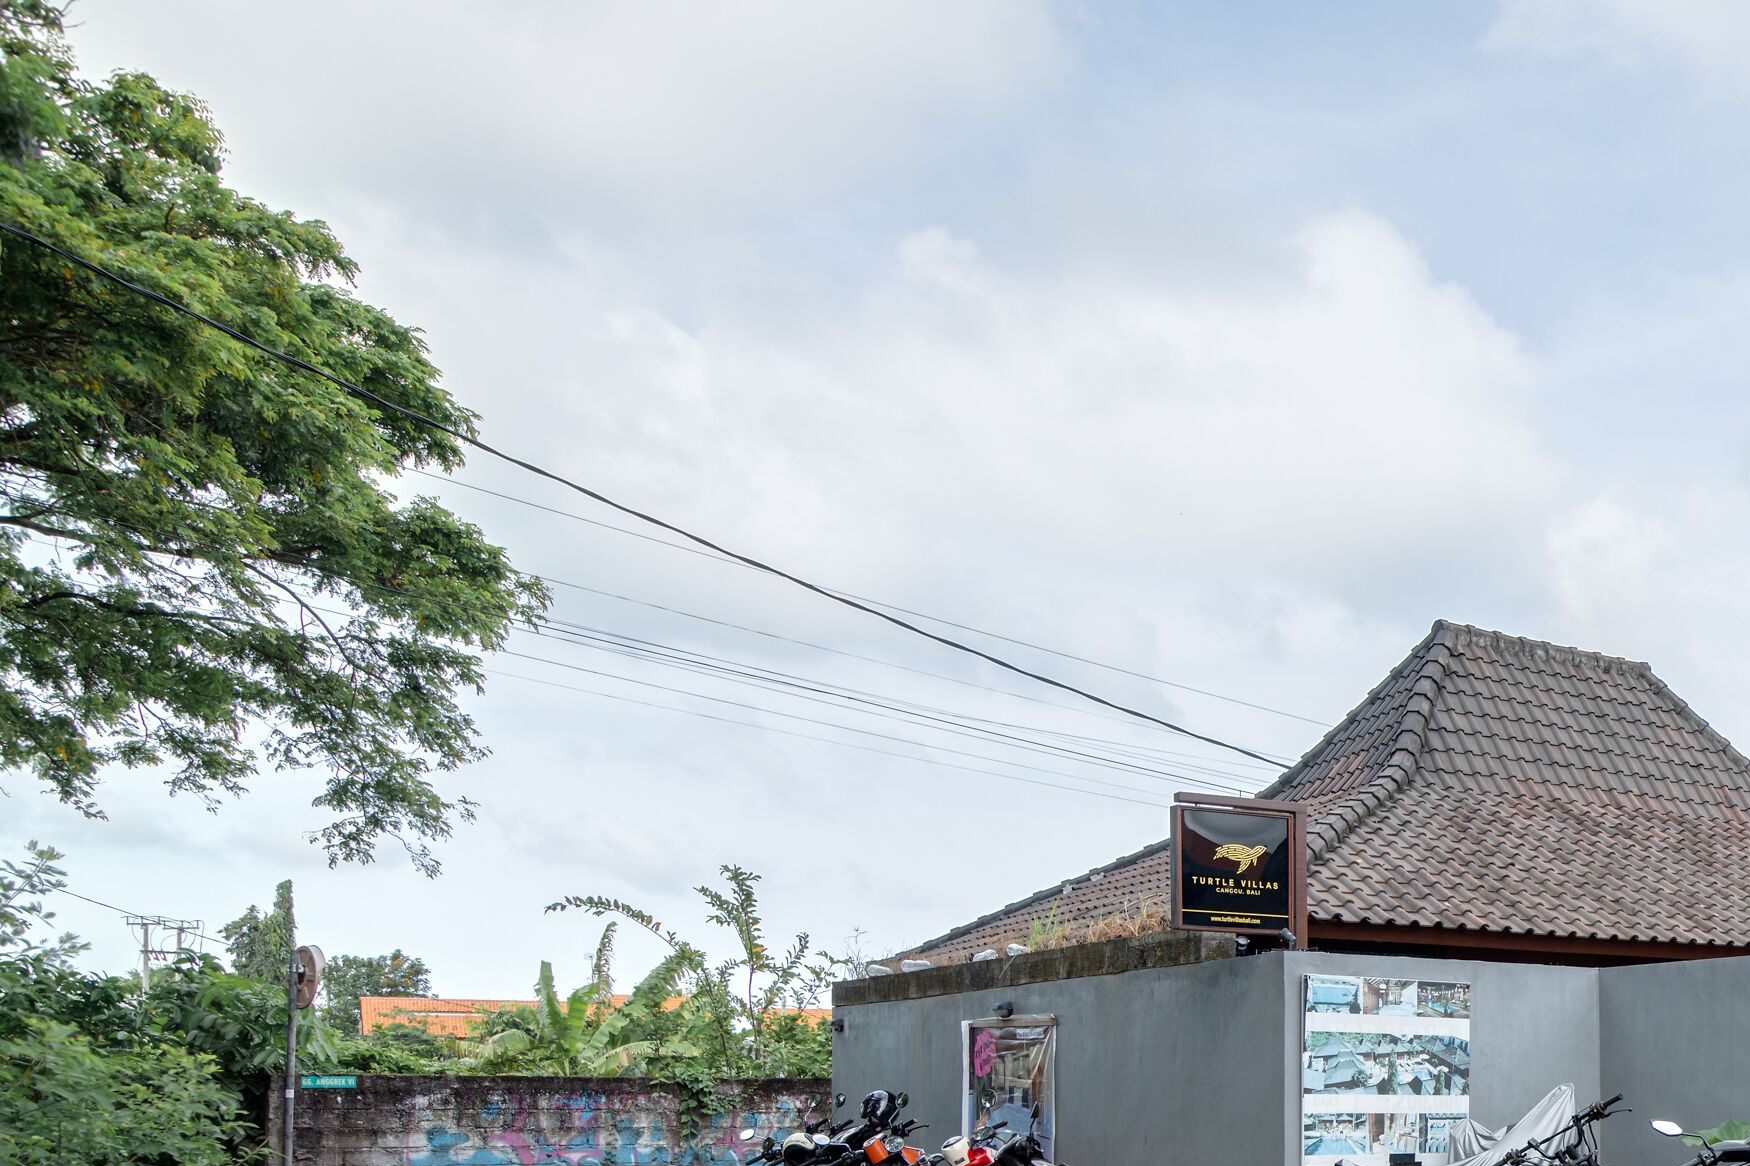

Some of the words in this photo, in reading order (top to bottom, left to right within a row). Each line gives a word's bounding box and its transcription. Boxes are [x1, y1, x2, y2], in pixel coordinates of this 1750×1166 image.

[1191, 876, 1235, 887] TURTLE
[1240, 880, 1279, 890] VILLAS
[316, 1078, 346, 1086] ANGGREK
